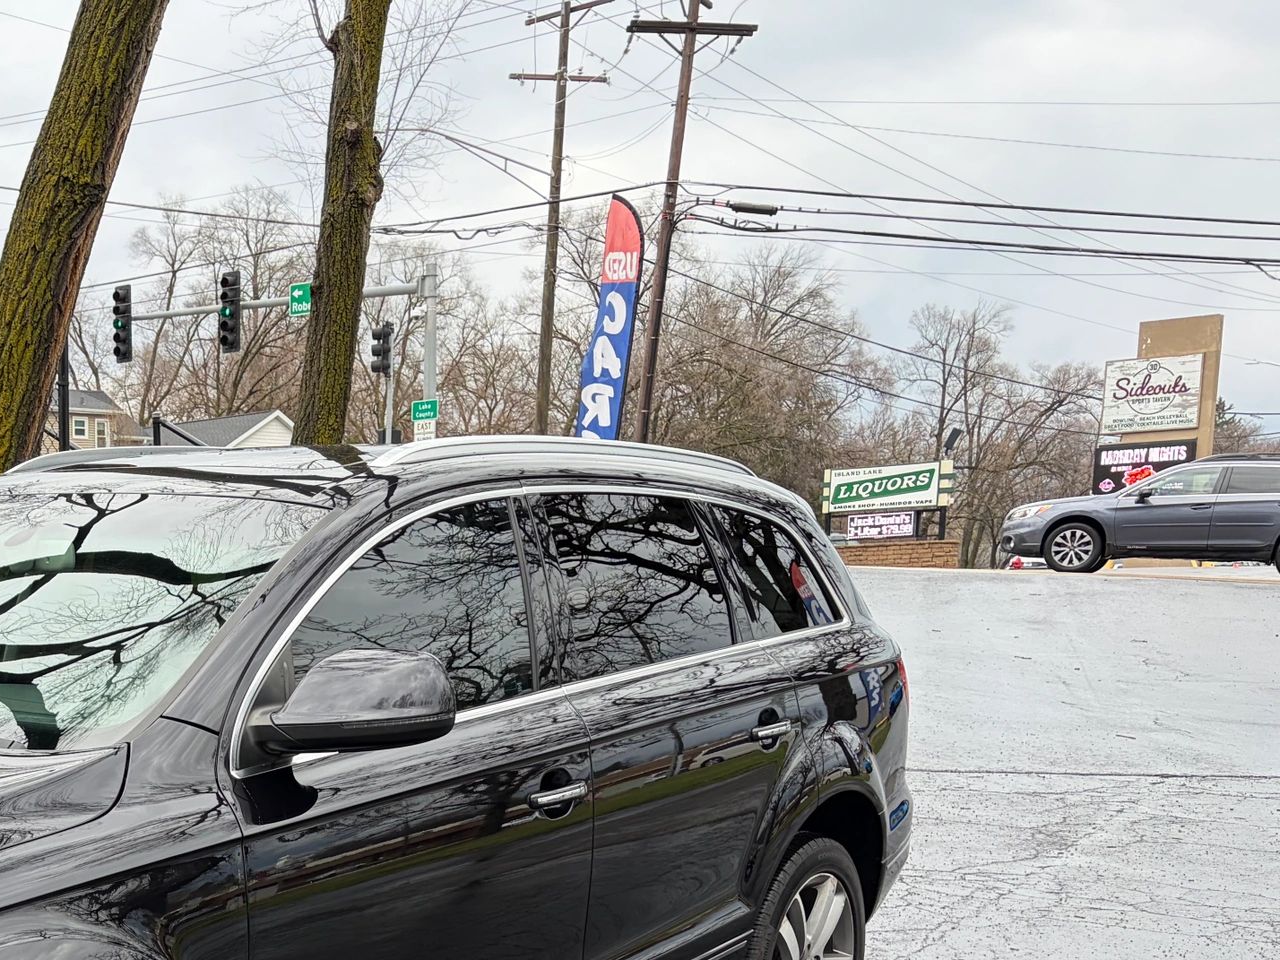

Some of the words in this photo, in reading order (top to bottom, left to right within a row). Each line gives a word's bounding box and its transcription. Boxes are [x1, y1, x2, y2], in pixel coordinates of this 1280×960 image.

[1113, 373, 1191, 400] Sideouts
[417, 422, 431, 431] EAST
[1100, 448, 1148, 466] MONDAY
[1148, 445, 1187, 462] NIGHTS
[834, 470, 861, 478] ISLAND
[837, 472, 931, 499] LIQUORS
[850, 517, 874, 527] Jack
